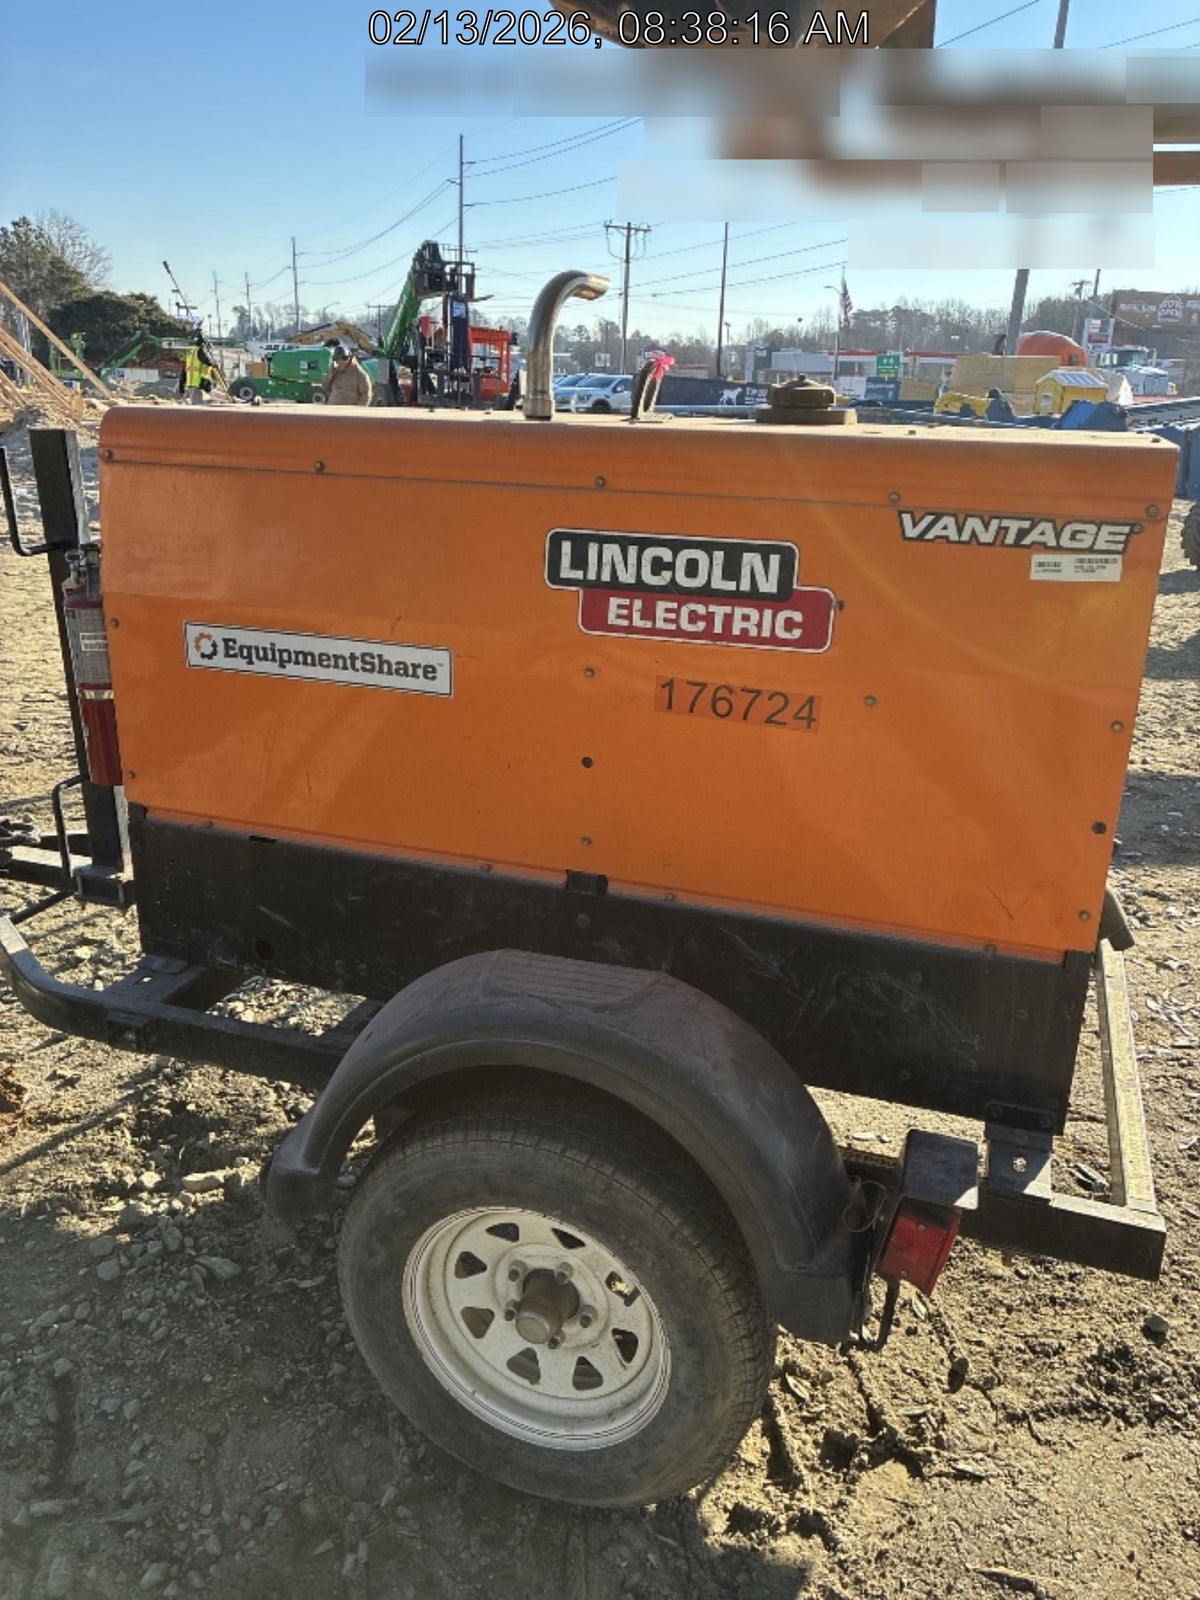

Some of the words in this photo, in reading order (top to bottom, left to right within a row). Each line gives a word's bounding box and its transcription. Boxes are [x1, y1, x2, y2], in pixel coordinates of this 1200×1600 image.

[900, 512, 1132, 551] VANTAGE
[559, 540, 781, 594] LINCOLN
[607, 596, 804, 640] ELECTRIC
[660, 677, 817, 730] 176724
